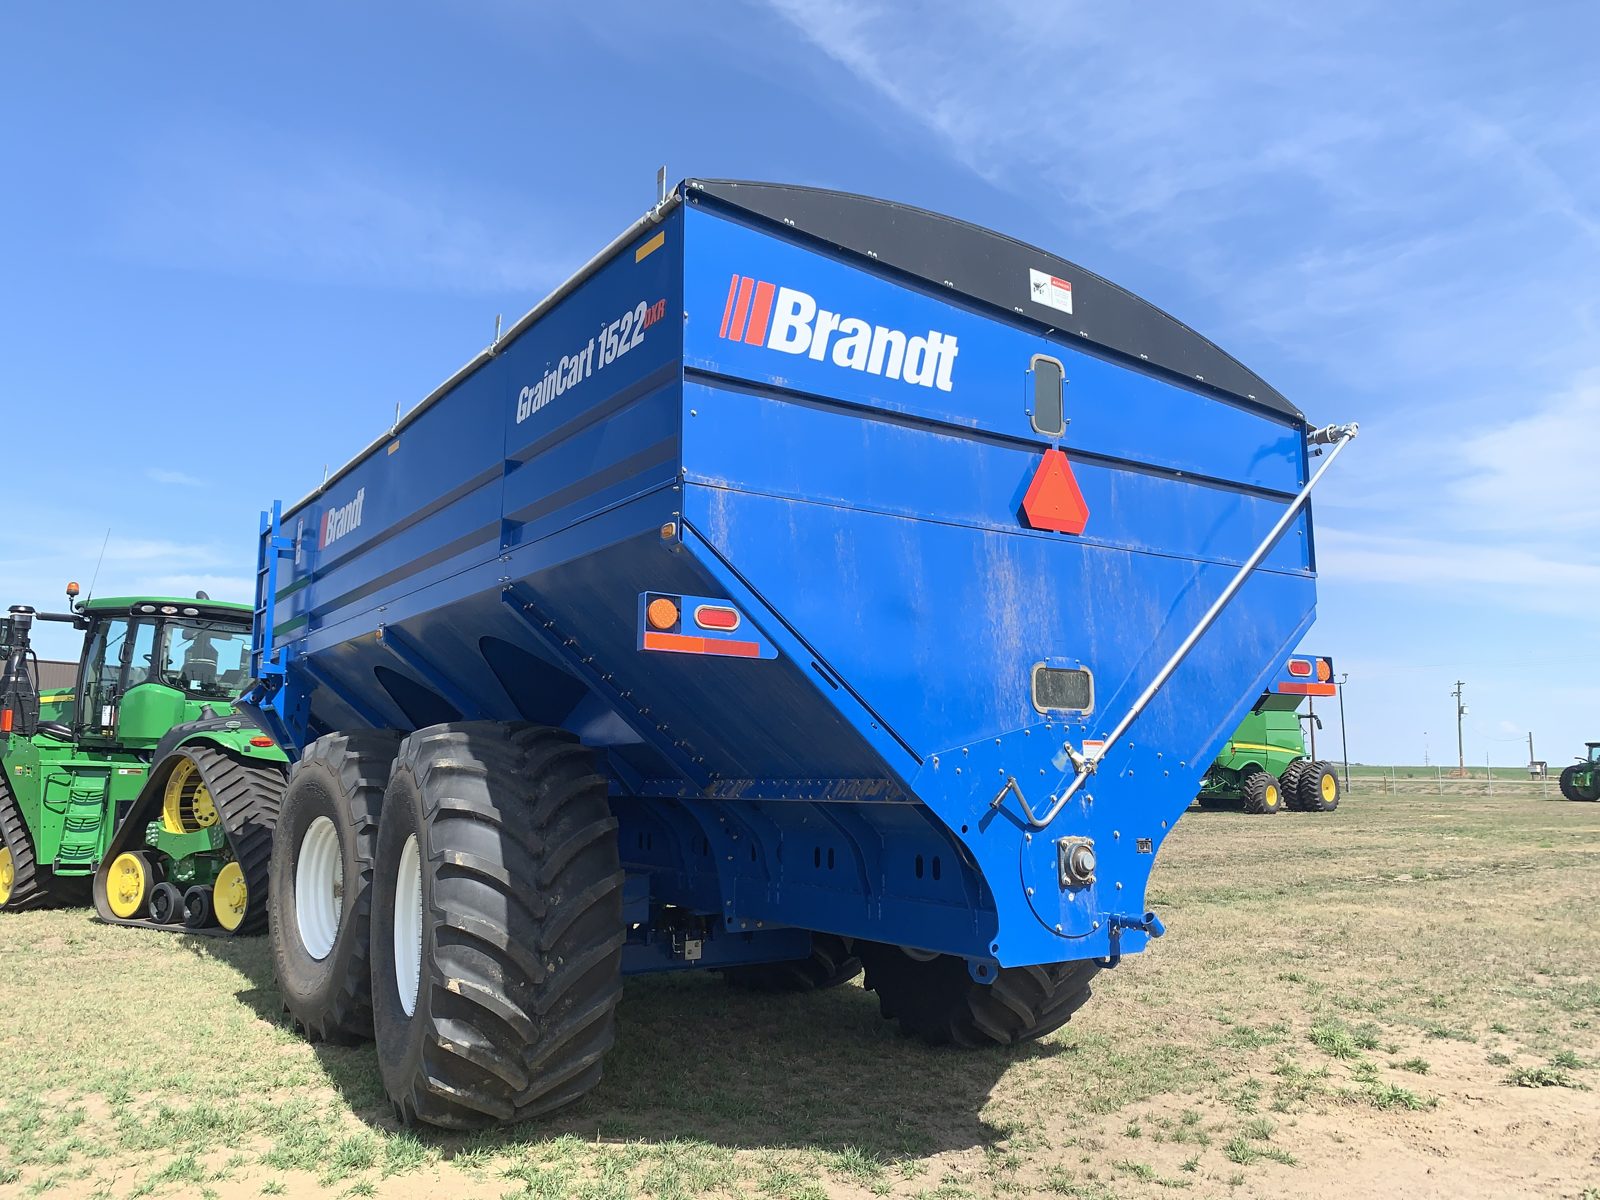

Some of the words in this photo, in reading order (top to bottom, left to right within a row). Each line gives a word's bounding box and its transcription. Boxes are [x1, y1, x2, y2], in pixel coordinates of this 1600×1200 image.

[516, 338, 594, 424] GrainCart
[767, 286, 959, 392] Brandt
[325, 487, 365, 546] Brandt
